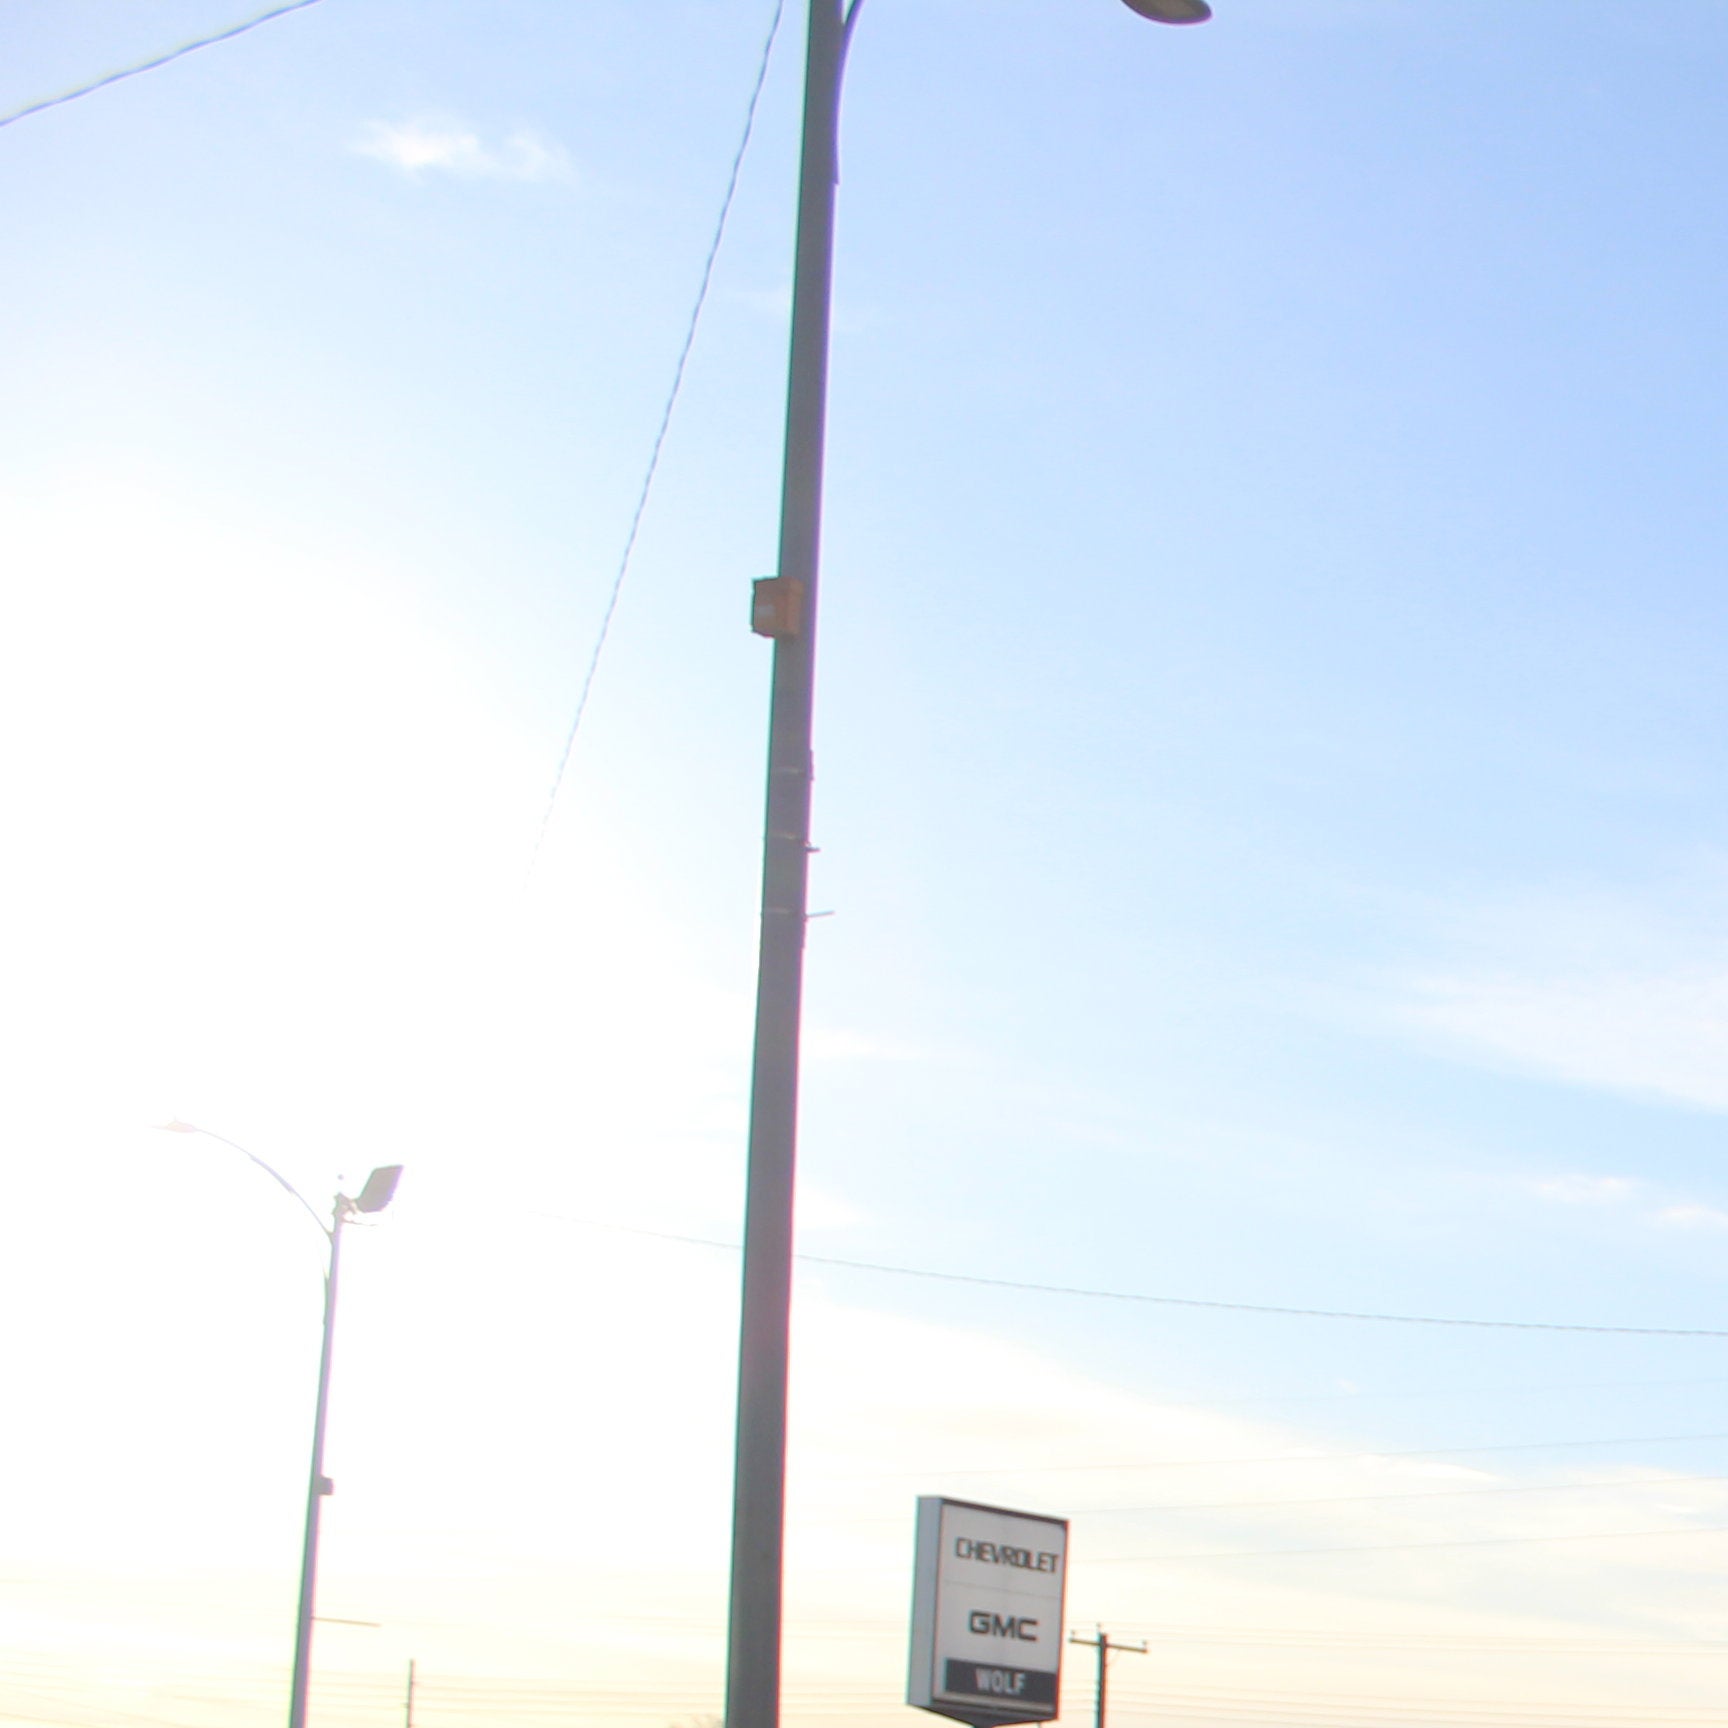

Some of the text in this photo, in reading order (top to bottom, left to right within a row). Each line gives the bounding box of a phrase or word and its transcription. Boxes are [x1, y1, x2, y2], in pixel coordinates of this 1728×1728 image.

[955, 1536, 1059, 1573] CHEVROLET
[969, 1610, 1039, 1642] GMC
[975, 1667, 1027, 1696] WOLF
